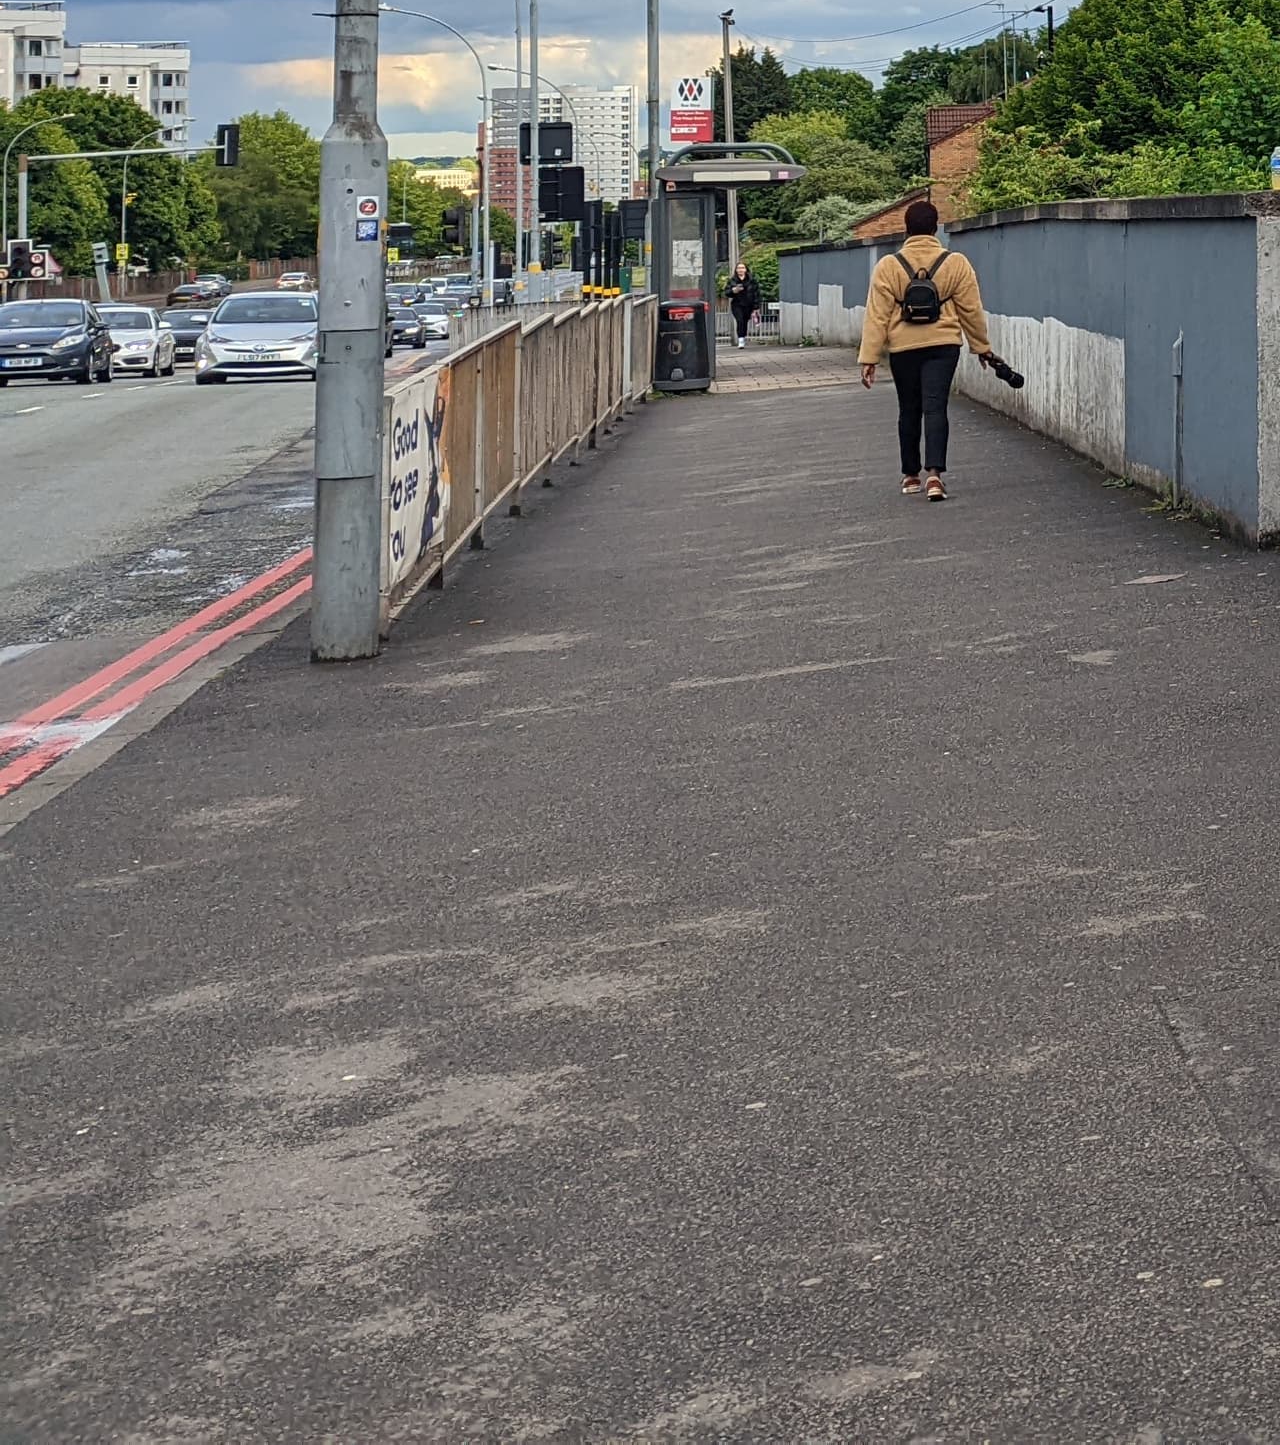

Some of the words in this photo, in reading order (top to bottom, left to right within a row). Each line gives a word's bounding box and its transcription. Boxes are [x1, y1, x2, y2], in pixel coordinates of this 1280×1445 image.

[393, 409, 420, 461] Good
[391, 475, 403, 511] to
[404, 468, 419, 507] see
[391, 525, 407, 563] ou
